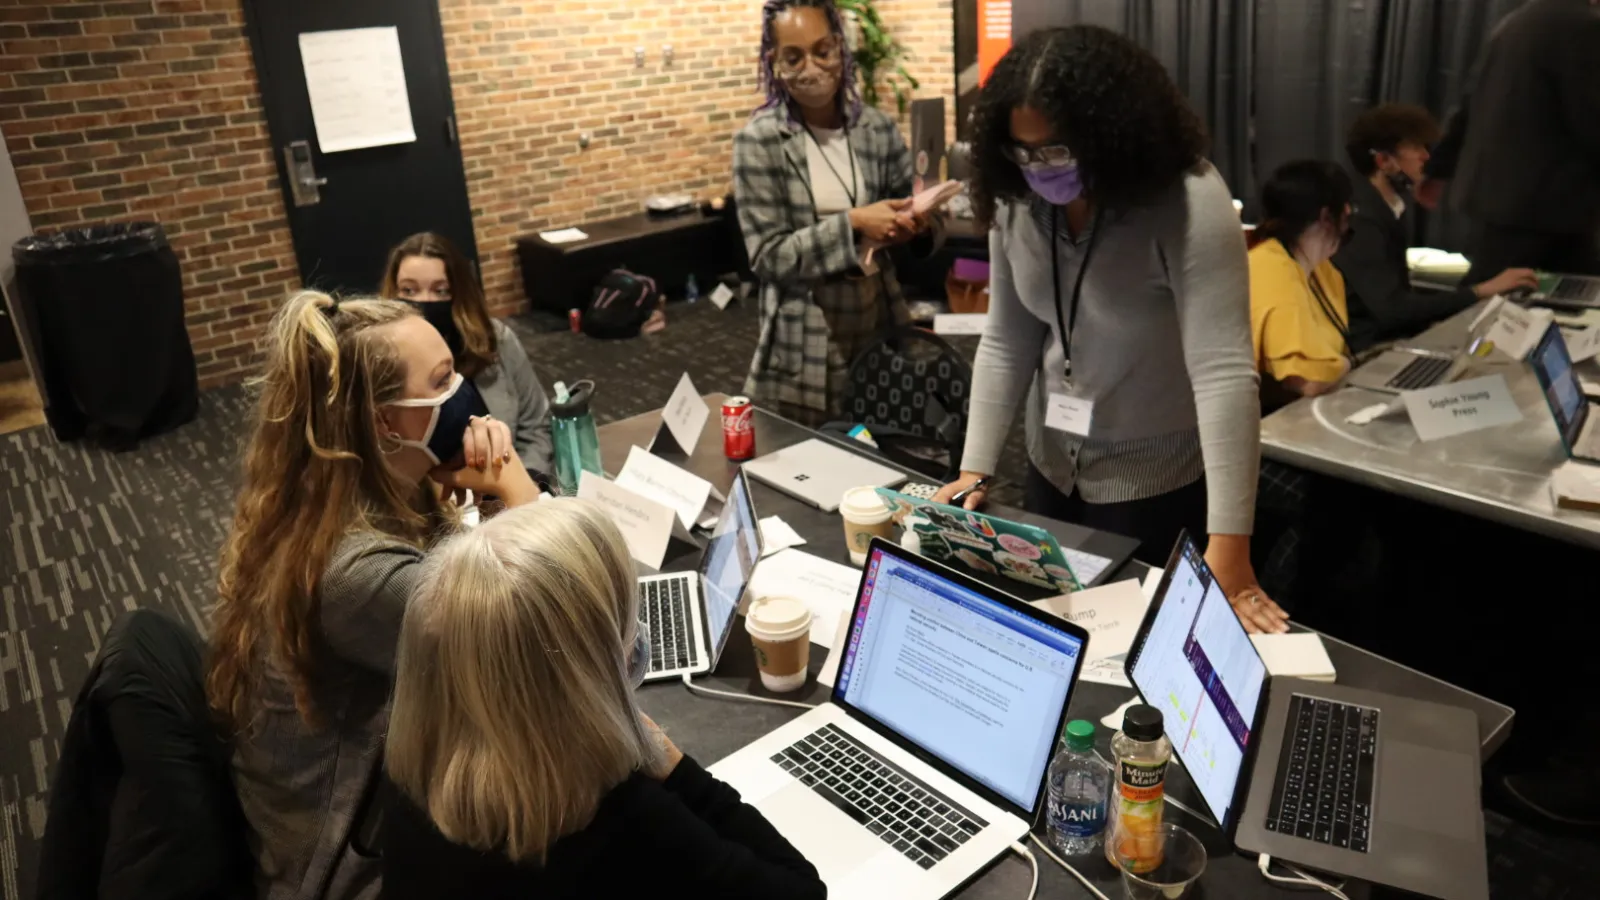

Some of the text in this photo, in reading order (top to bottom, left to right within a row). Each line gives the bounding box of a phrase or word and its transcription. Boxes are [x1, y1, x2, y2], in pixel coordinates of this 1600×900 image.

[1428, 391, 1490, 410] Sophie Young
[1452, 407, 1478, 417] Press
[1131, 775, 1158, 785] Maid
